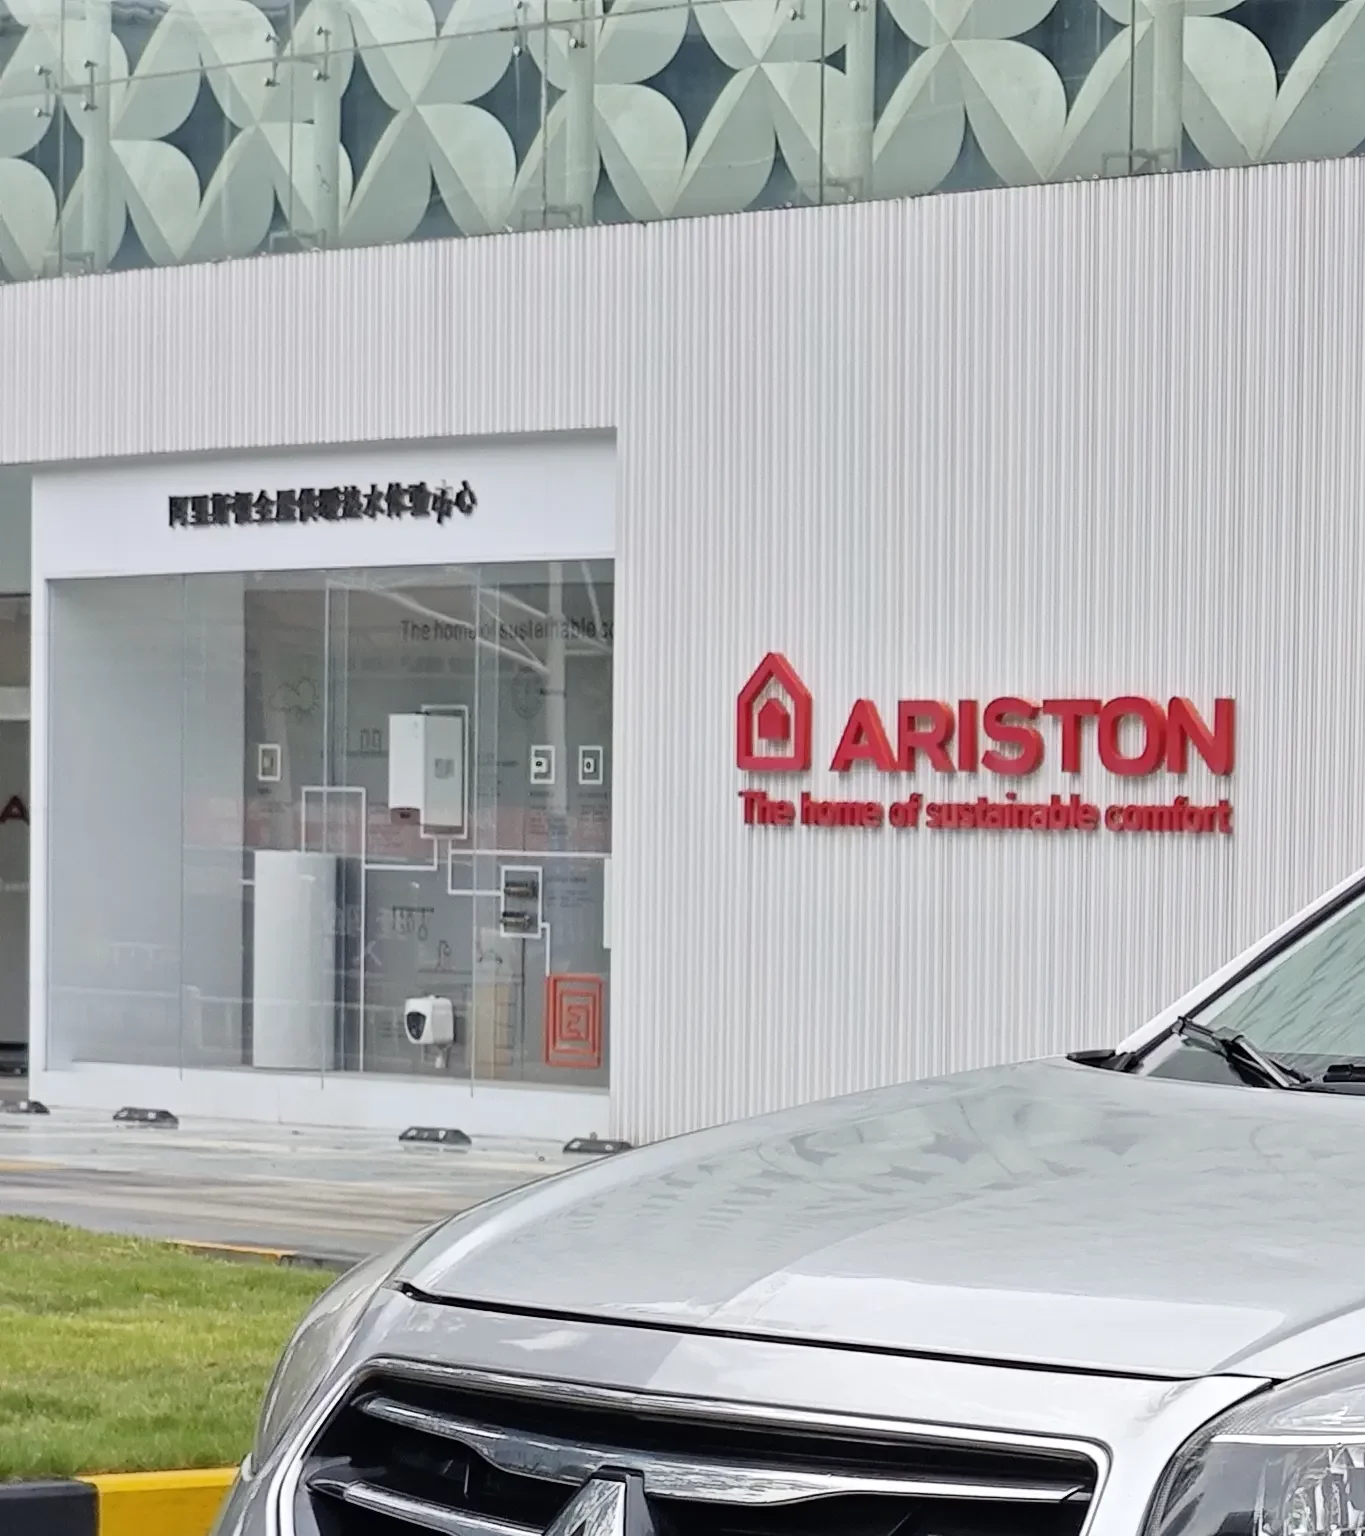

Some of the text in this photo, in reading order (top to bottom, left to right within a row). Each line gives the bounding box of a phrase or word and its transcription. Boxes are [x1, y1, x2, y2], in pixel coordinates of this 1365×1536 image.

[829, 695, 1236, 777] ARISTON
[738, 788, 1233, 834] The home of sustainable comfort
